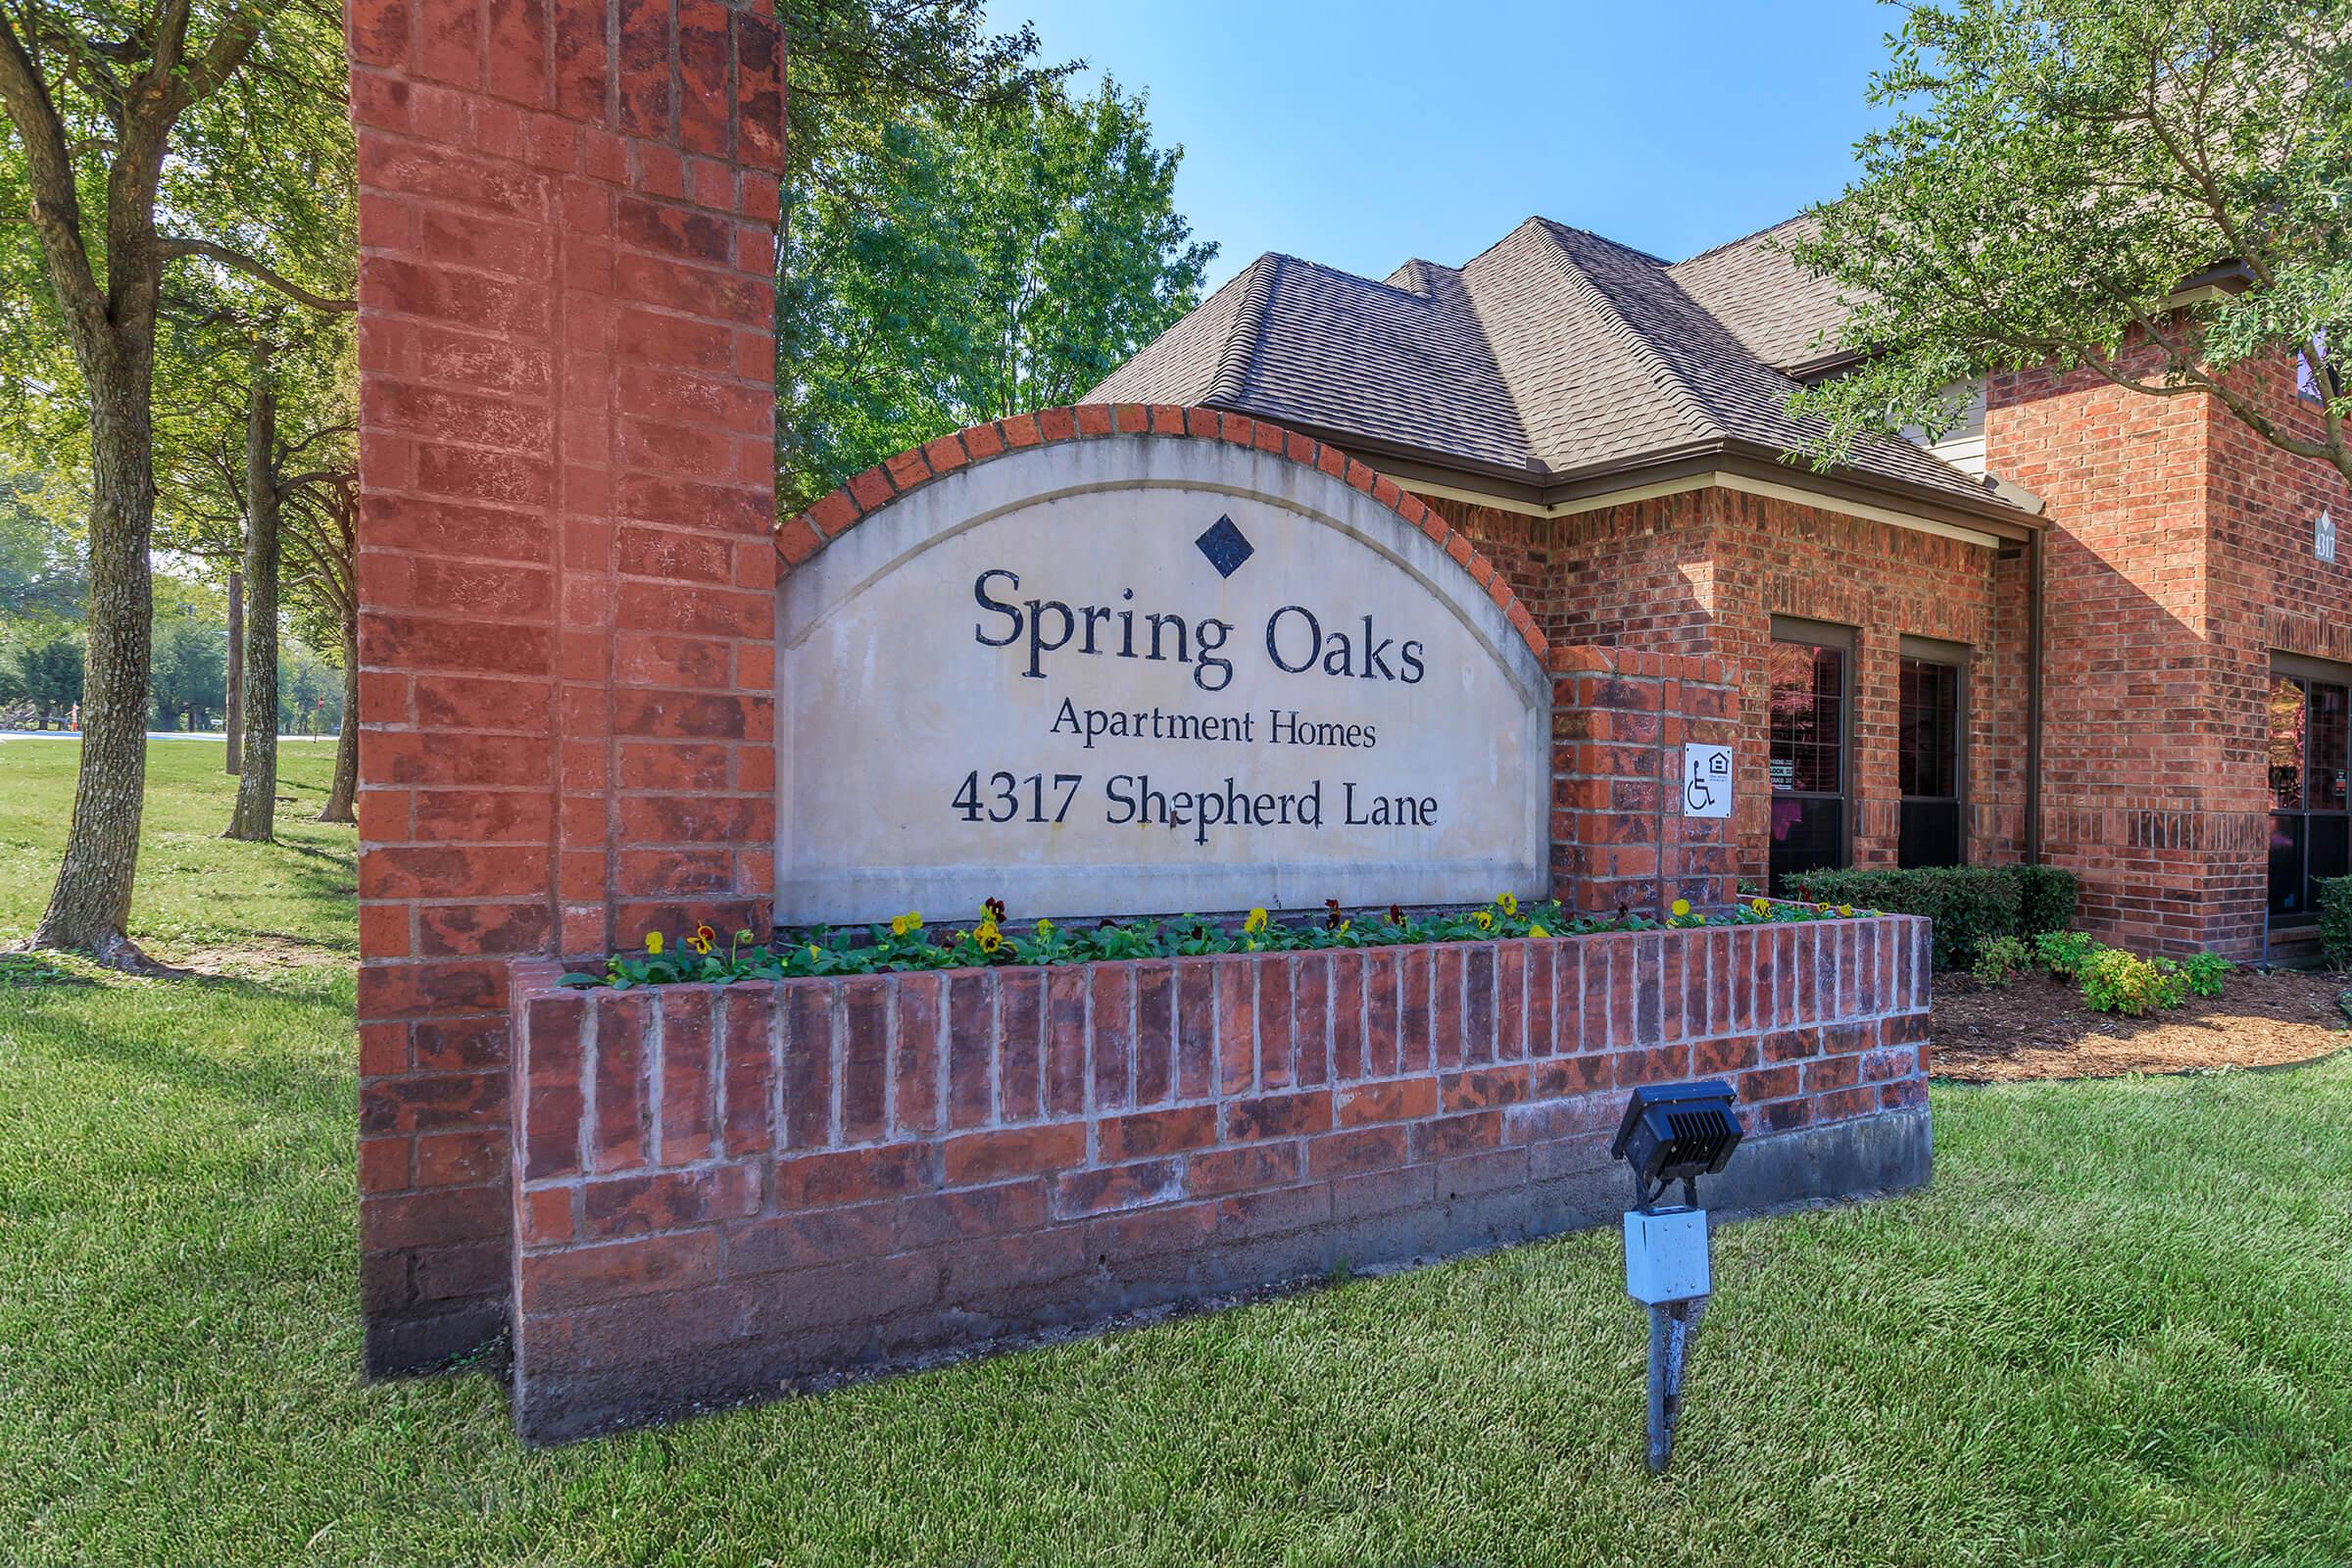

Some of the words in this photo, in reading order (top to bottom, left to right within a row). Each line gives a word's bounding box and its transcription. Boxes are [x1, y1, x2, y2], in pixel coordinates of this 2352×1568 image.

[2315, 532, 2334, 558] 4317
[974, 569, 1235, 692] Spring
[1266, 605, 1425, 684] Oaks
[1051, 697, 1254, 749] Apartment
[1269, 710, 1377, 748] Homes
[951, 770, 1082, 824] 4317
[1105, 775, 1322, 846] Shepherd
[1344, 782, 1438, 826] Lane
